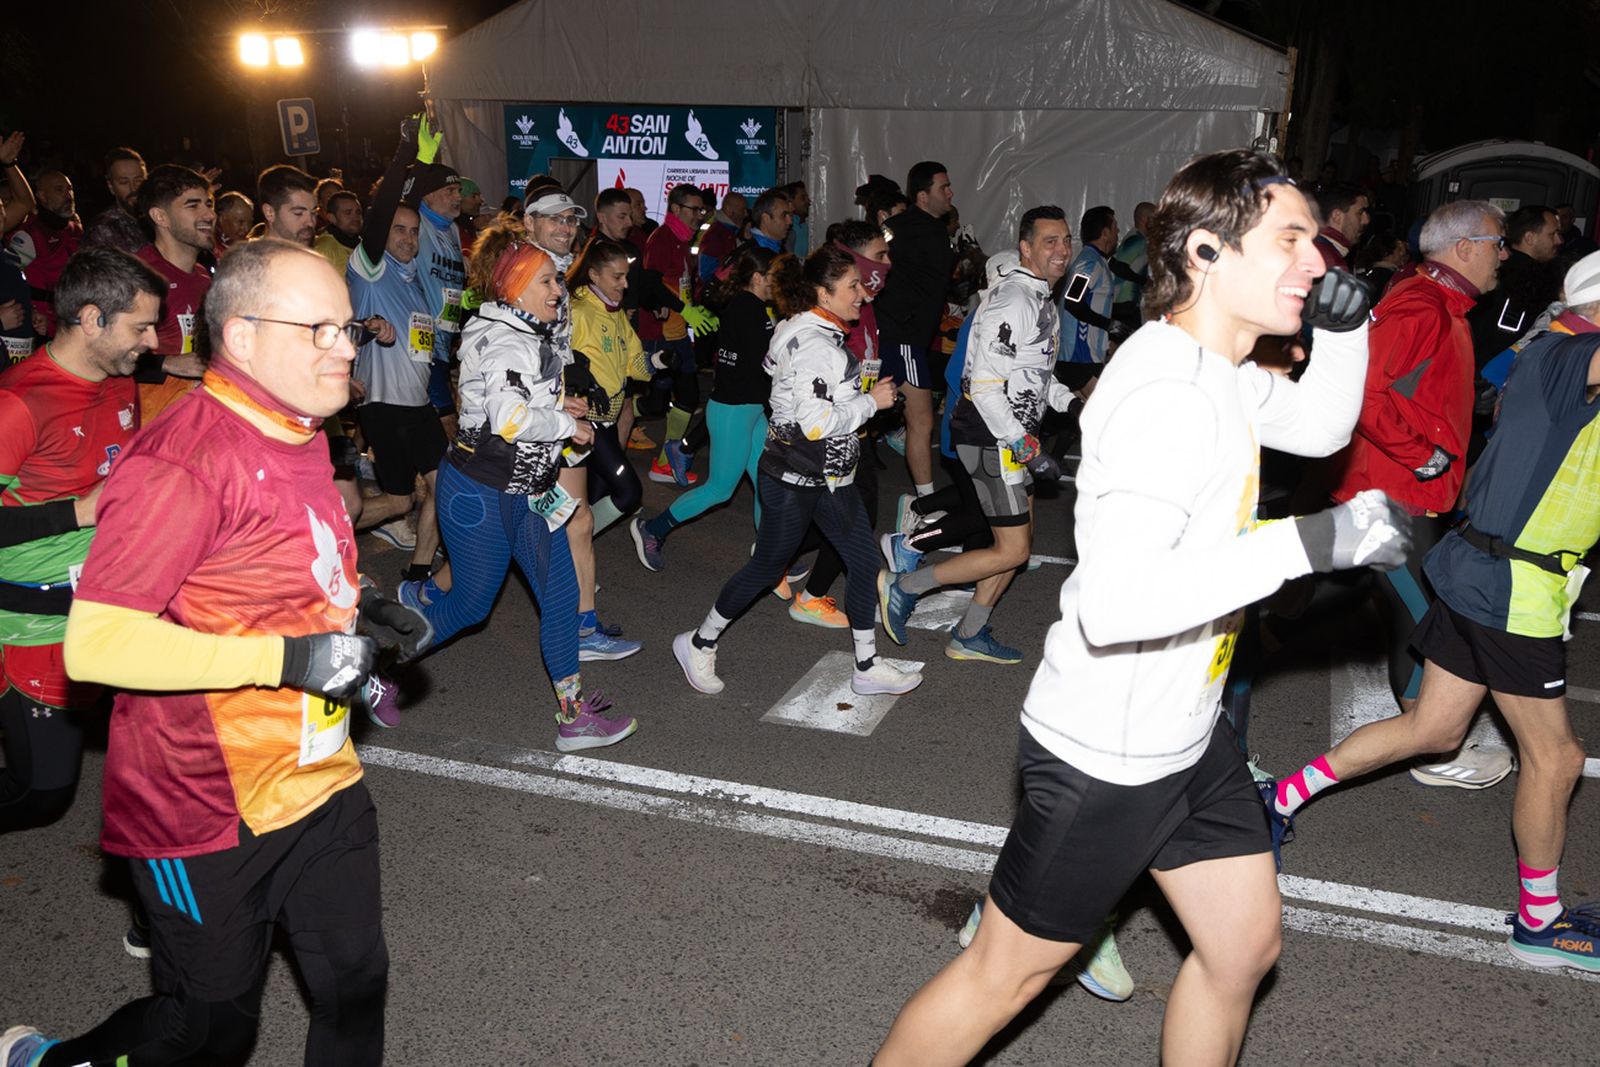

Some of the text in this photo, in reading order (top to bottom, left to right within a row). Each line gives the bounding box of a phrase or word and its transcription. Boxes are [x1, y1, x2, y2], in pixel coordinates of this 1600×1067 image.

[287, 106, 309, 149] P
[601, 131, 667, 155] ANTÓN
[1552, 937, 1593, 953] HOKA
